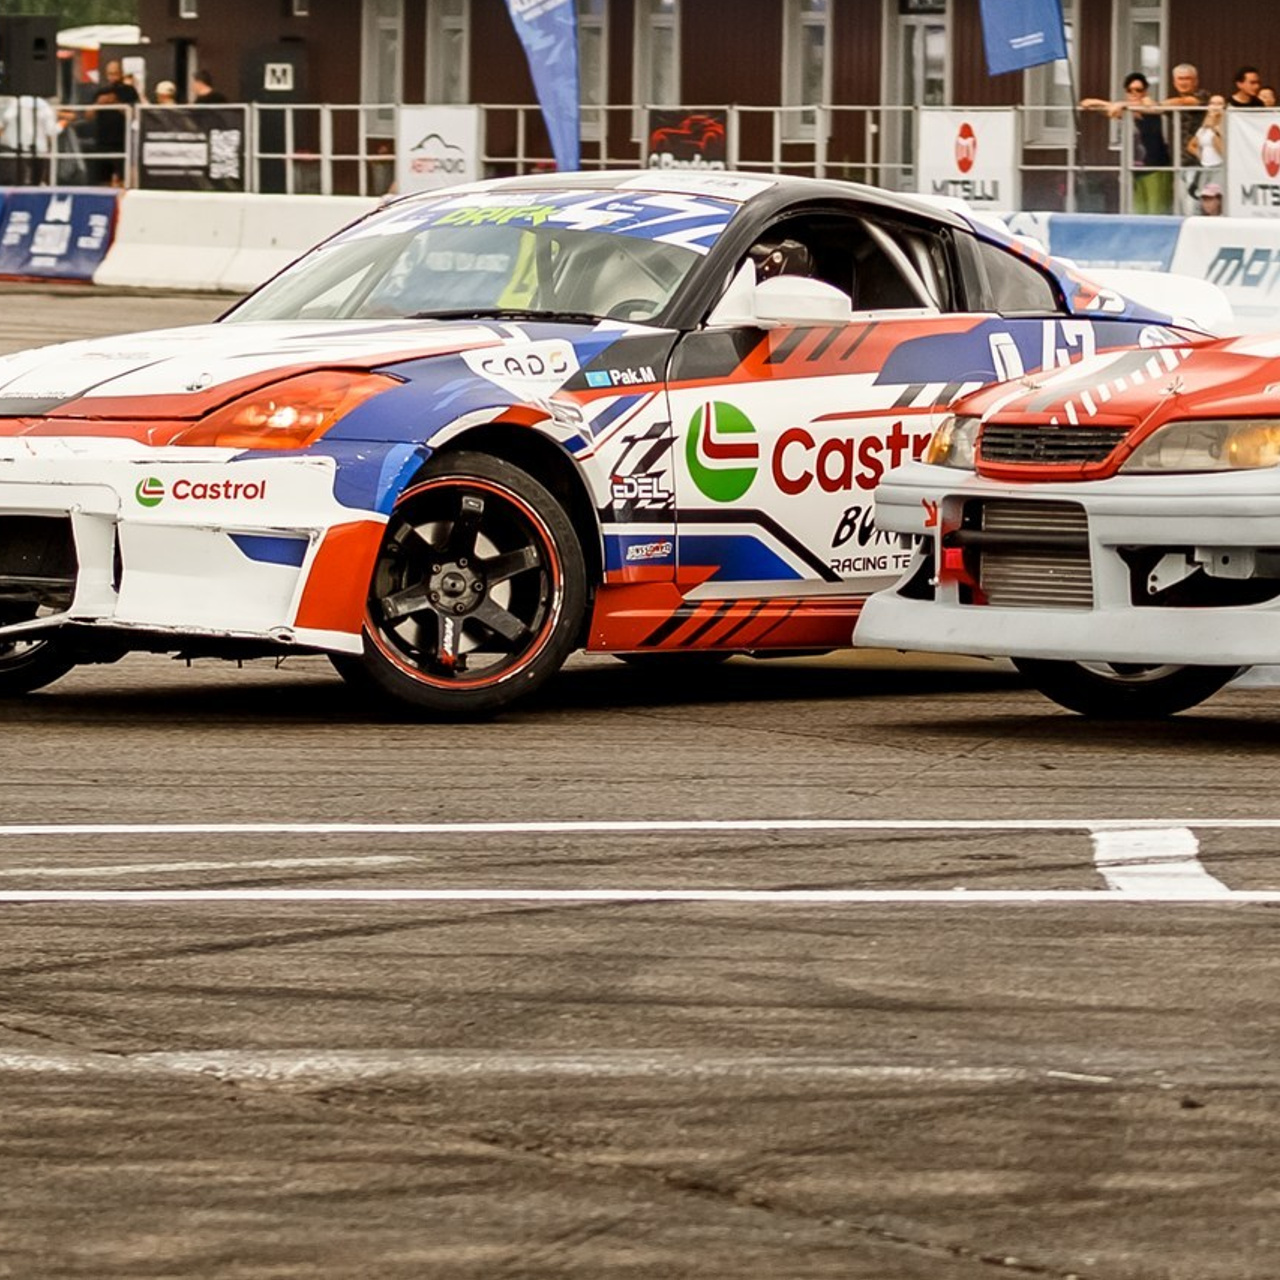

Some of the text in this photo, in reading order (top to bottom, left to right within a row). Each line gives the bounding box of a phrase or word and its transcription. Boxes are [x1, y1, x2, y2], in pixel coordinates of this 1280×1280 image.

[609, 366, 656, 386] Pak.M
[172, 479, 267, 501] Castrol
[830, 555, 887, 573] RACING
